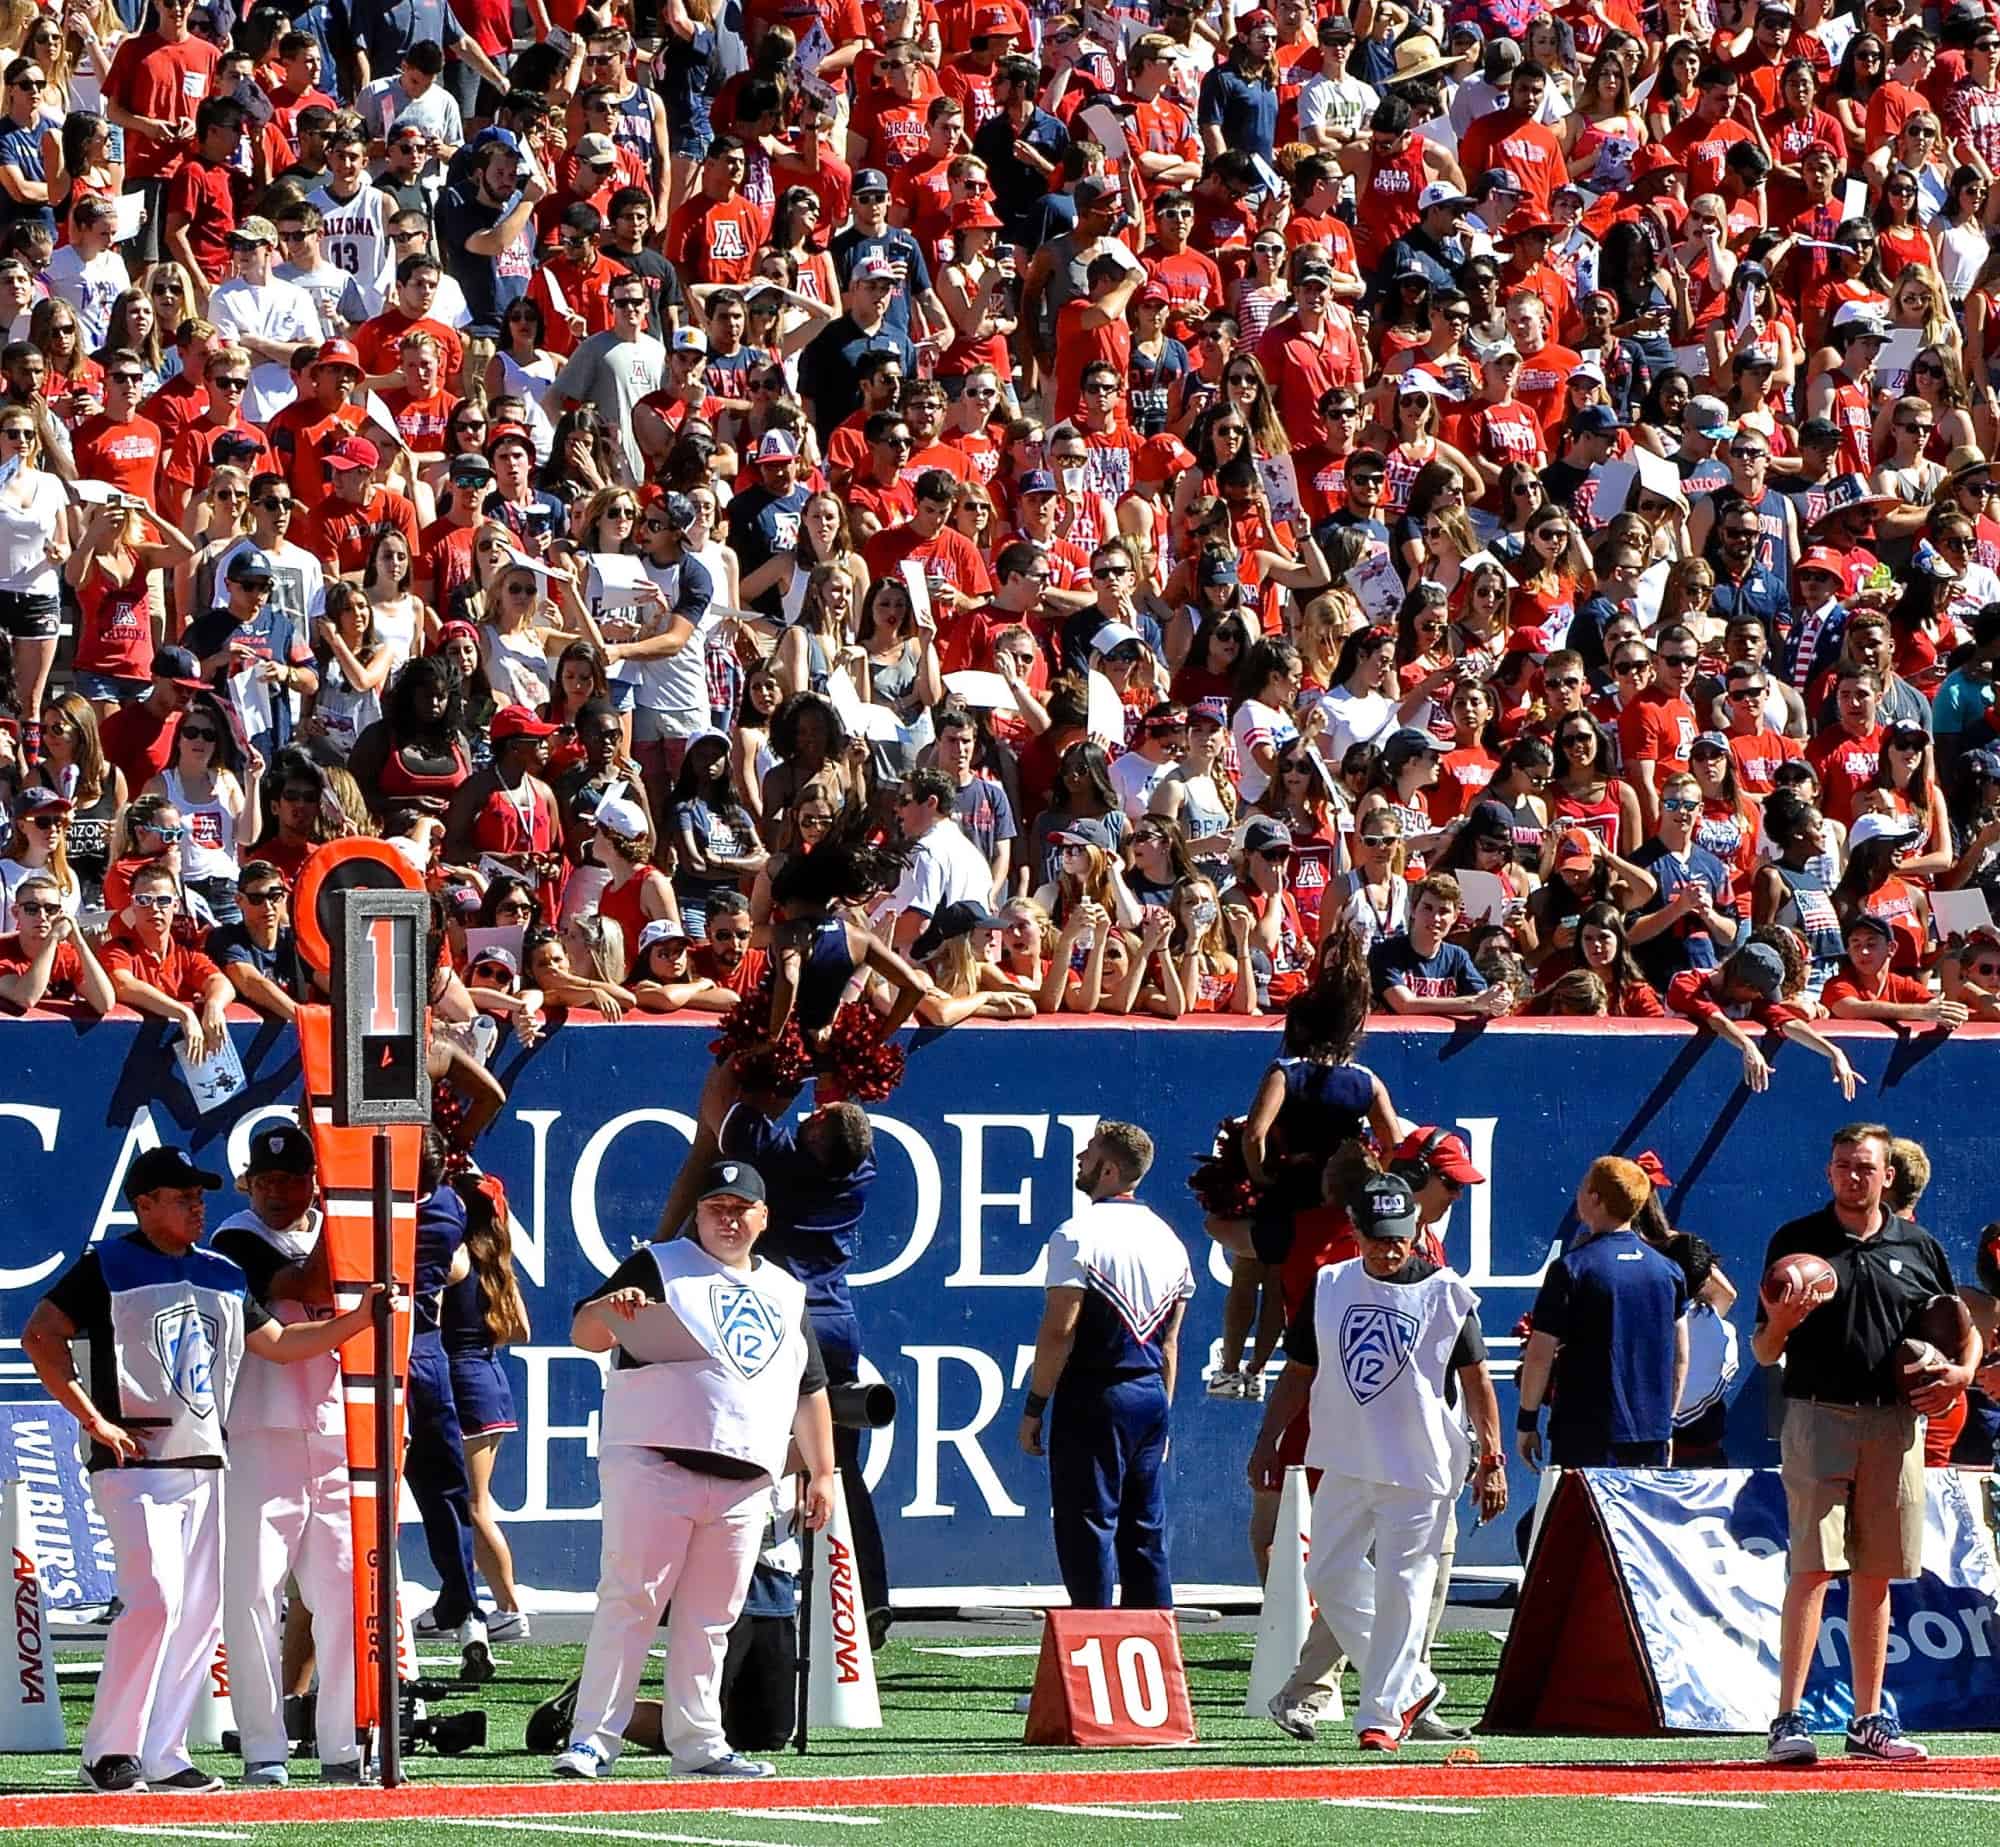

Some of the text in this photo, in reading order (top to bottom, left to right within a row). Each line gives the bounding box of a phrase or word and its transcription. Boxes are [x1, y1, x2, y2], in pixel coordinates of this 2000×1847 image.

[1092, 55, 1116, 88] 16
[322, 217, 374, 238] RIZONA
[711, 221, 749, 259] A
[331, 243, 359, 274] 13
[630, 360, 650, 385] A
[765, 438, 780, 454] A
[1680, 477, 1727, 493] ARIZONA
[112, 602, 137, 625] A
[1296, 857, 1325, 888] A
[364, 917, 398, 1035] 1
[1372, 1195, 1406, 1211] 100
[736, 1333, 761, 1360] 12
[1354, 1357, 1385, 1385] 12
[10, 1419, 83, 1602] WILBUR'S
[827, 1534, 860, 1684] ARIZONA
[12, 1546, 46, 1704] ARIZONA
[1070, 1636, 1170, 1728] 10
